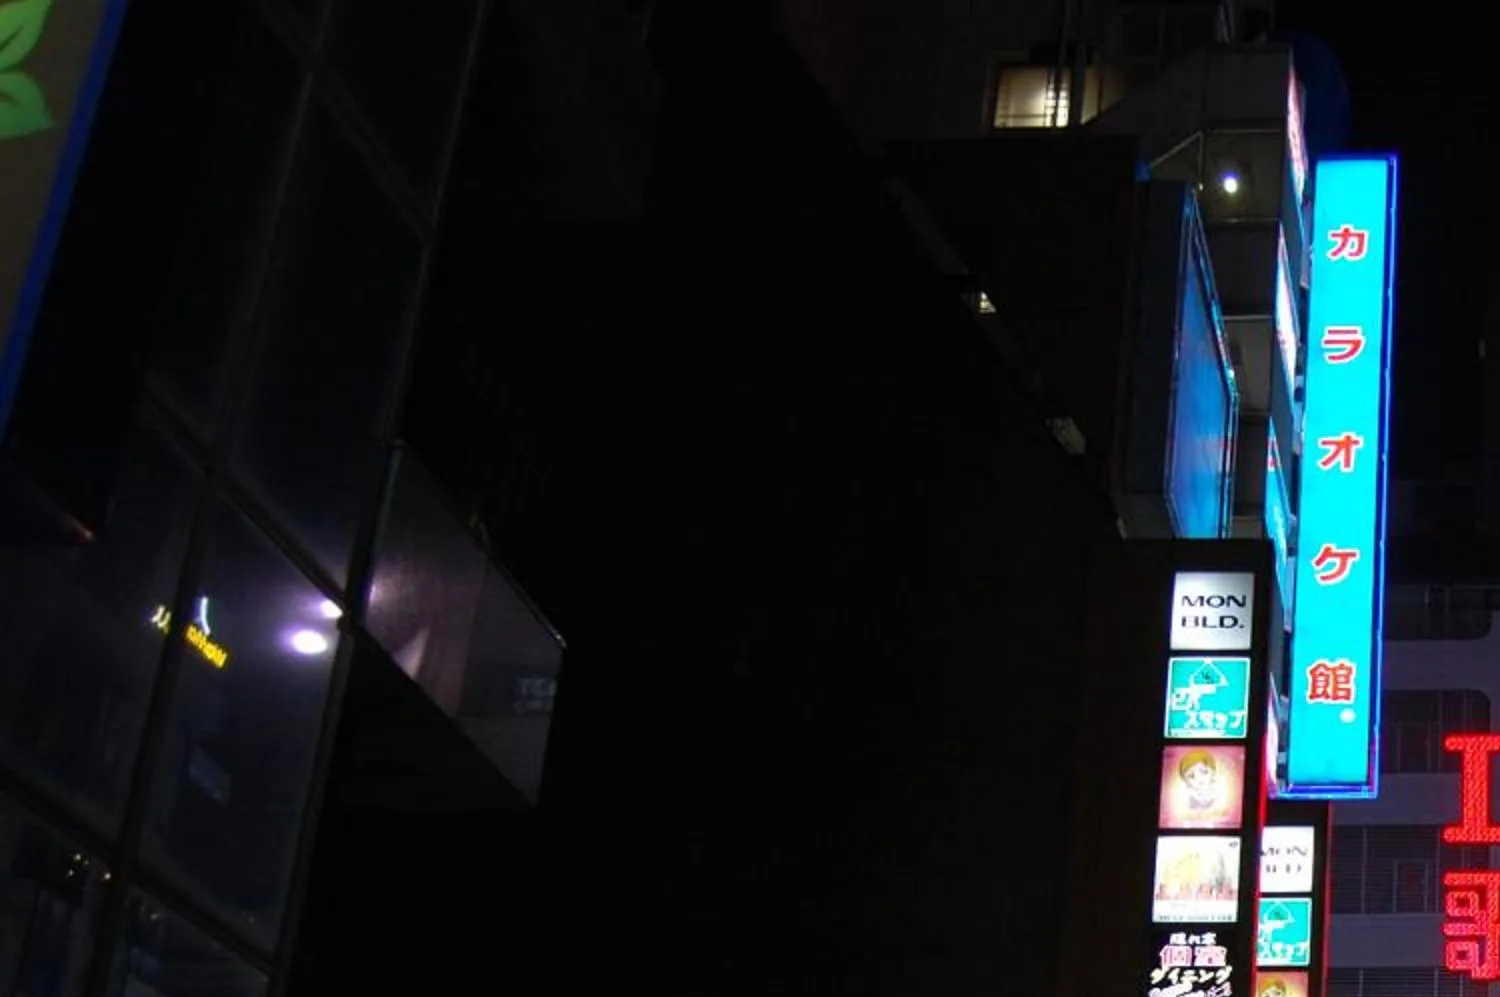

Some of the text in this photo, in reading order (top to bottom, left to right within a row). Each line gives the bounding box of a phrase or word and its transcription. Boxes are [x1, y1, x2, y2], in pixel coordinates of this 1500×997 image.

[1307, 224, 1370, 704] カラオケ館
[1181, 594, 1247, 609] MON
